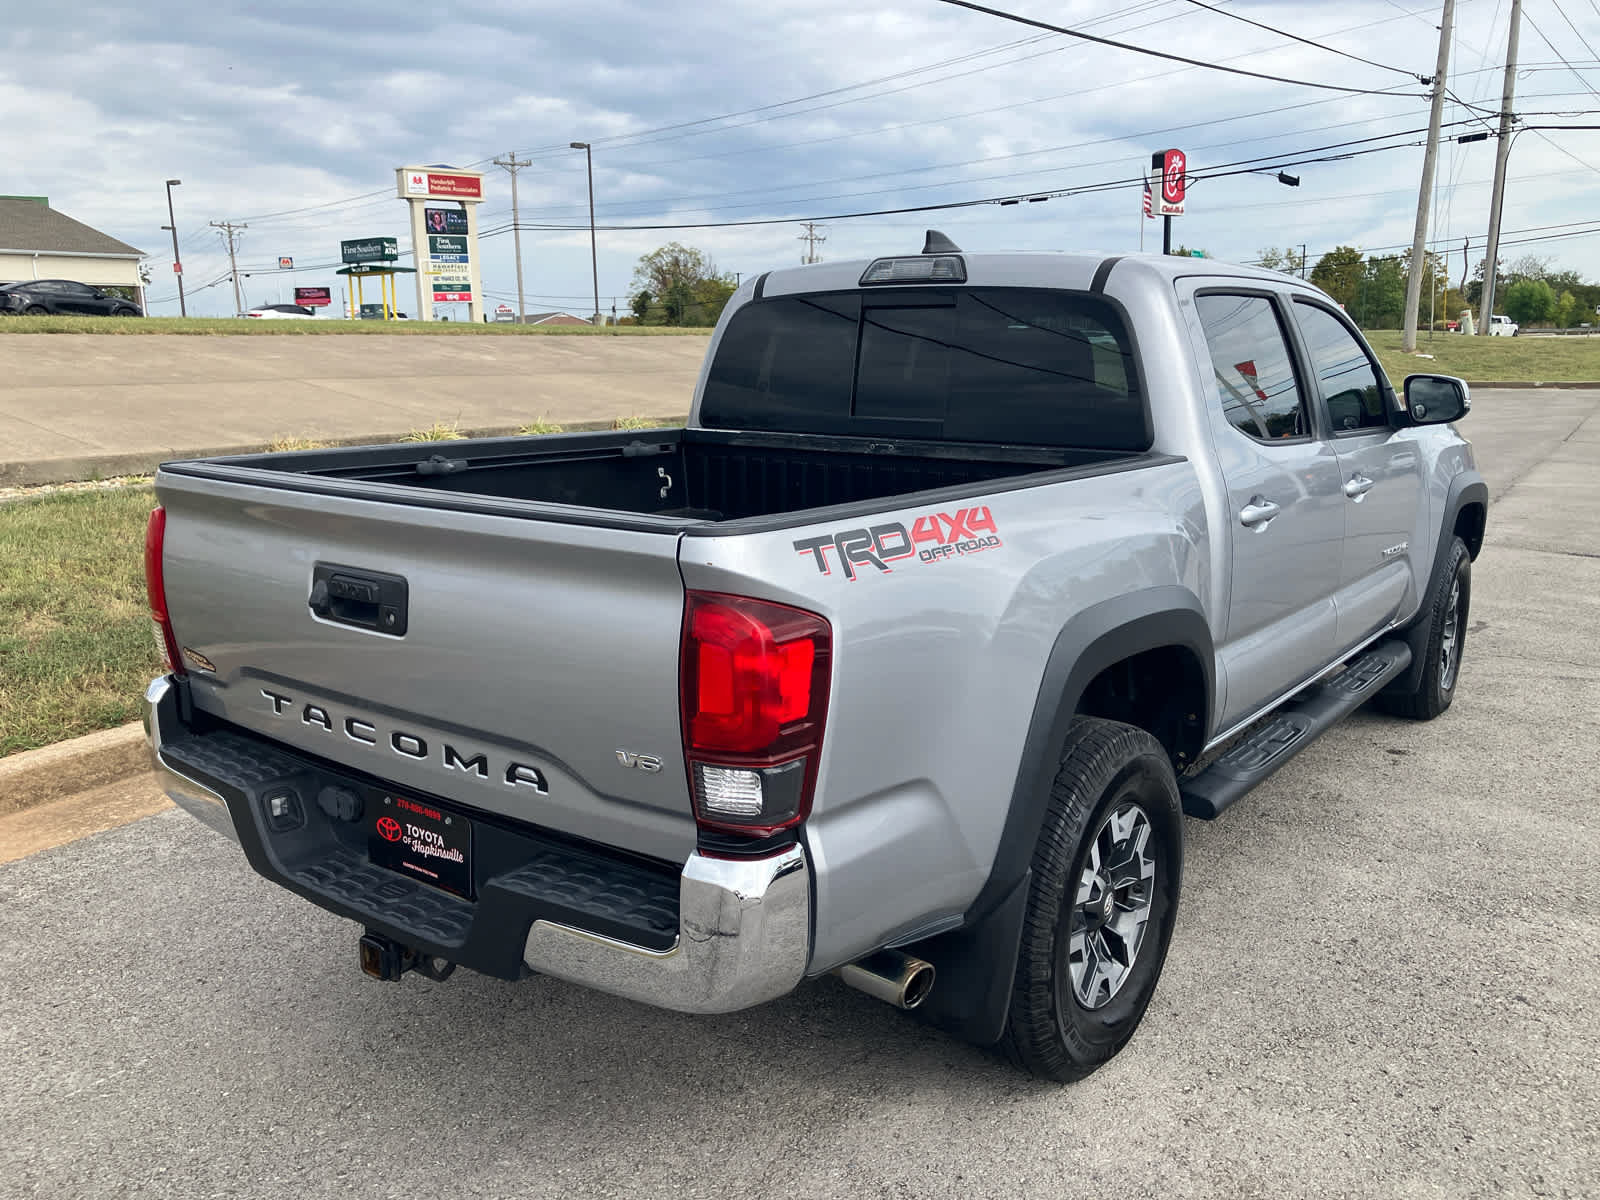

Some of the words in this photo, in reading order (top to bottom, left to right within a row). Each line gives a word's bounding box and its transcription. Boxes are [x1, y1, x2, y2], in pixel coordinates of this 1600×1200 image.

[343, 245, 357, 254] First
[356, 243, 382, 254] Southern
[384, 247, 397, 255] ATM
[792, 522, 915, 582] TRD
[911, 505, 998, 544] 4X4
[919, 545, 953, 564] OFF
[955, 535, 1002, 556] ROAD
[261, 688, 548, 795] TACOMA
[615, 749, 663, 771] V6
[406, 823, 445, 848] TOYOTA
[402, 836, 412, 844] OF
[411, 839, 464, 863] Hopkinsville
